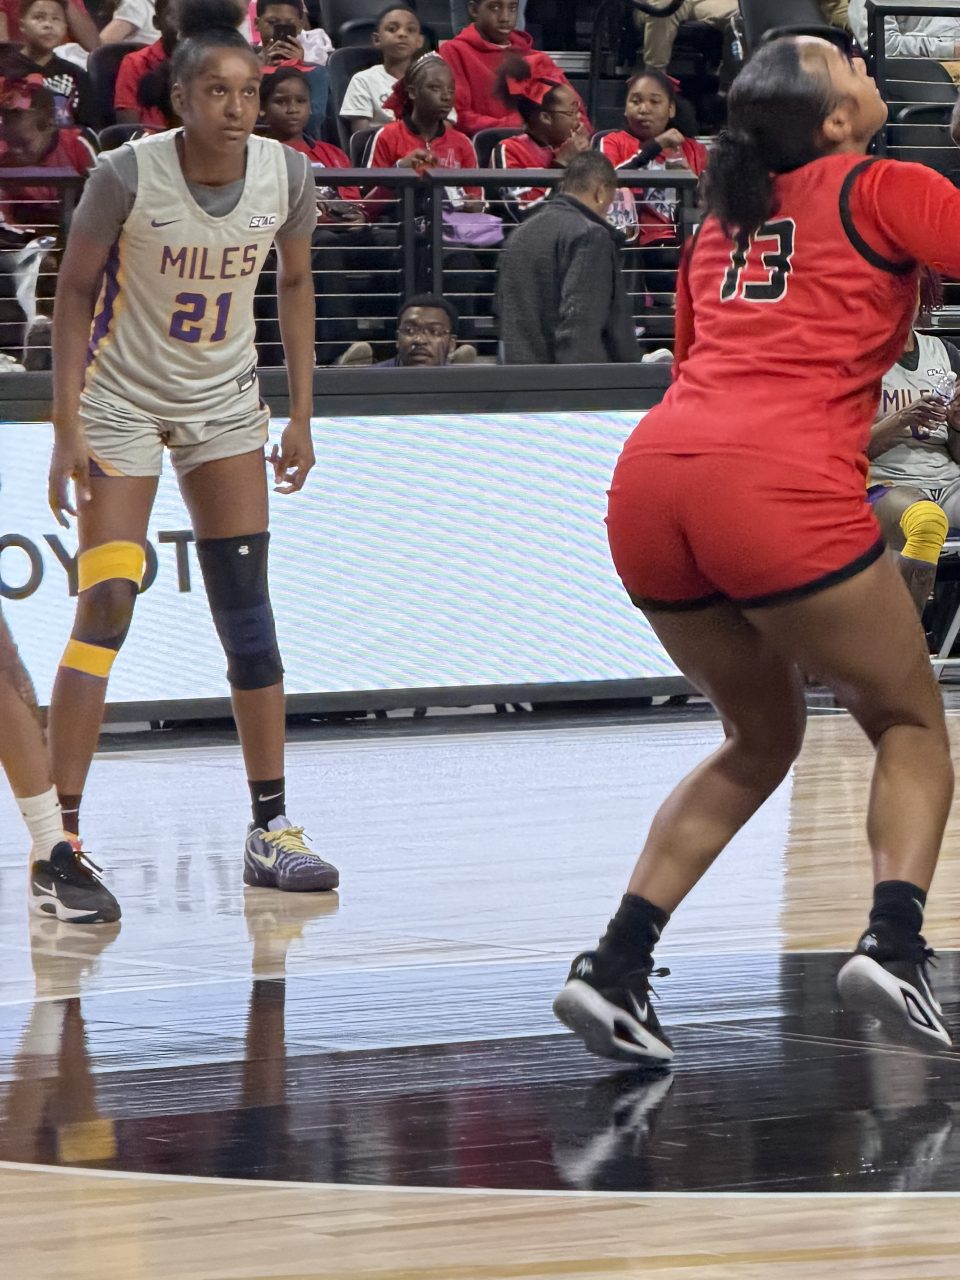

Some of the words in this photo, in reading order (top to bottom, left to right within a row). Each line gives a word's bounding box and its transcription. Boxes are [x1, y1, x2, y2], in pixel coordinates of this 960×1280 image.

[160, 244, 256, 281] MILES
[720, 217, 796, 303] 13
[169, 291, 232, 343] 21
